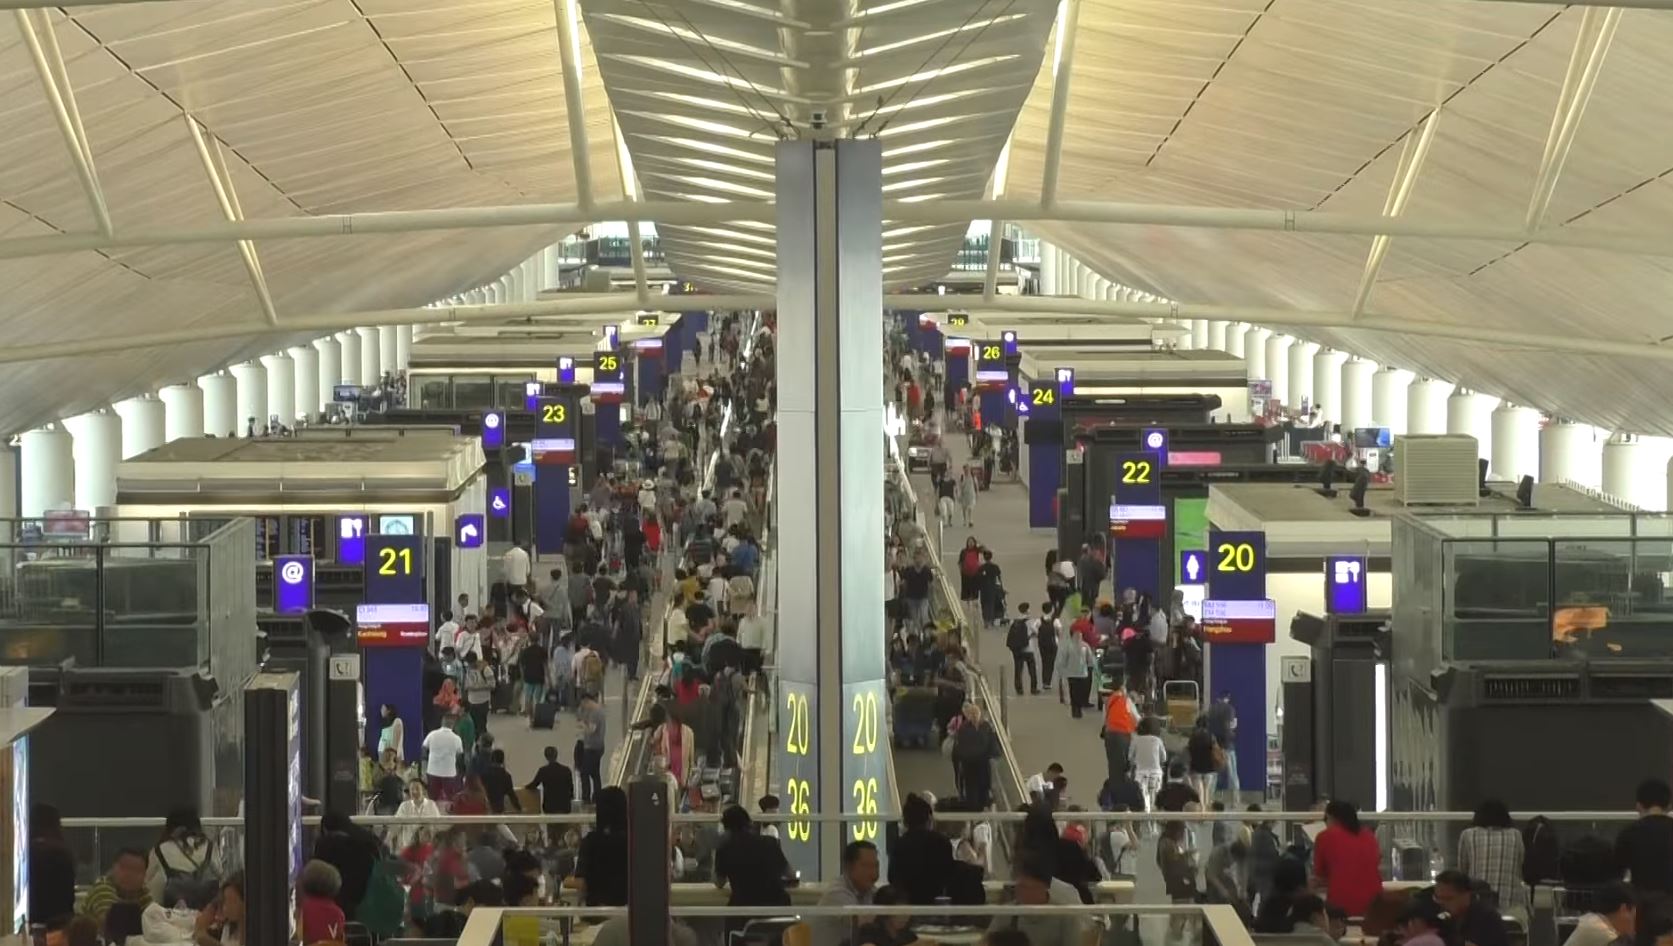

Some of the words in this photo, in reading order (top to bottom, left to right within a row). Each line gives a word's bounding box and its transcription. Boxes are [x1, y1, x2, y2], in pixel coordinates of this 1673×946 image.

[599, 356, 617, 371] 25
[984, 346, 1001, 360] 26
[1032, 389, 1055, 405] 24
[543, 405, 566, 423] 23
[1122, 462, 1151, 484] 22
[378, 548, 412, 576] 21
[1217, 543, 1255, 572] 20
[787, 692, 809, 756] 20
[853, 691, 878, 755] 20
[787, 777, 810, 842] 36
[852, 777, 878, 842] 36
